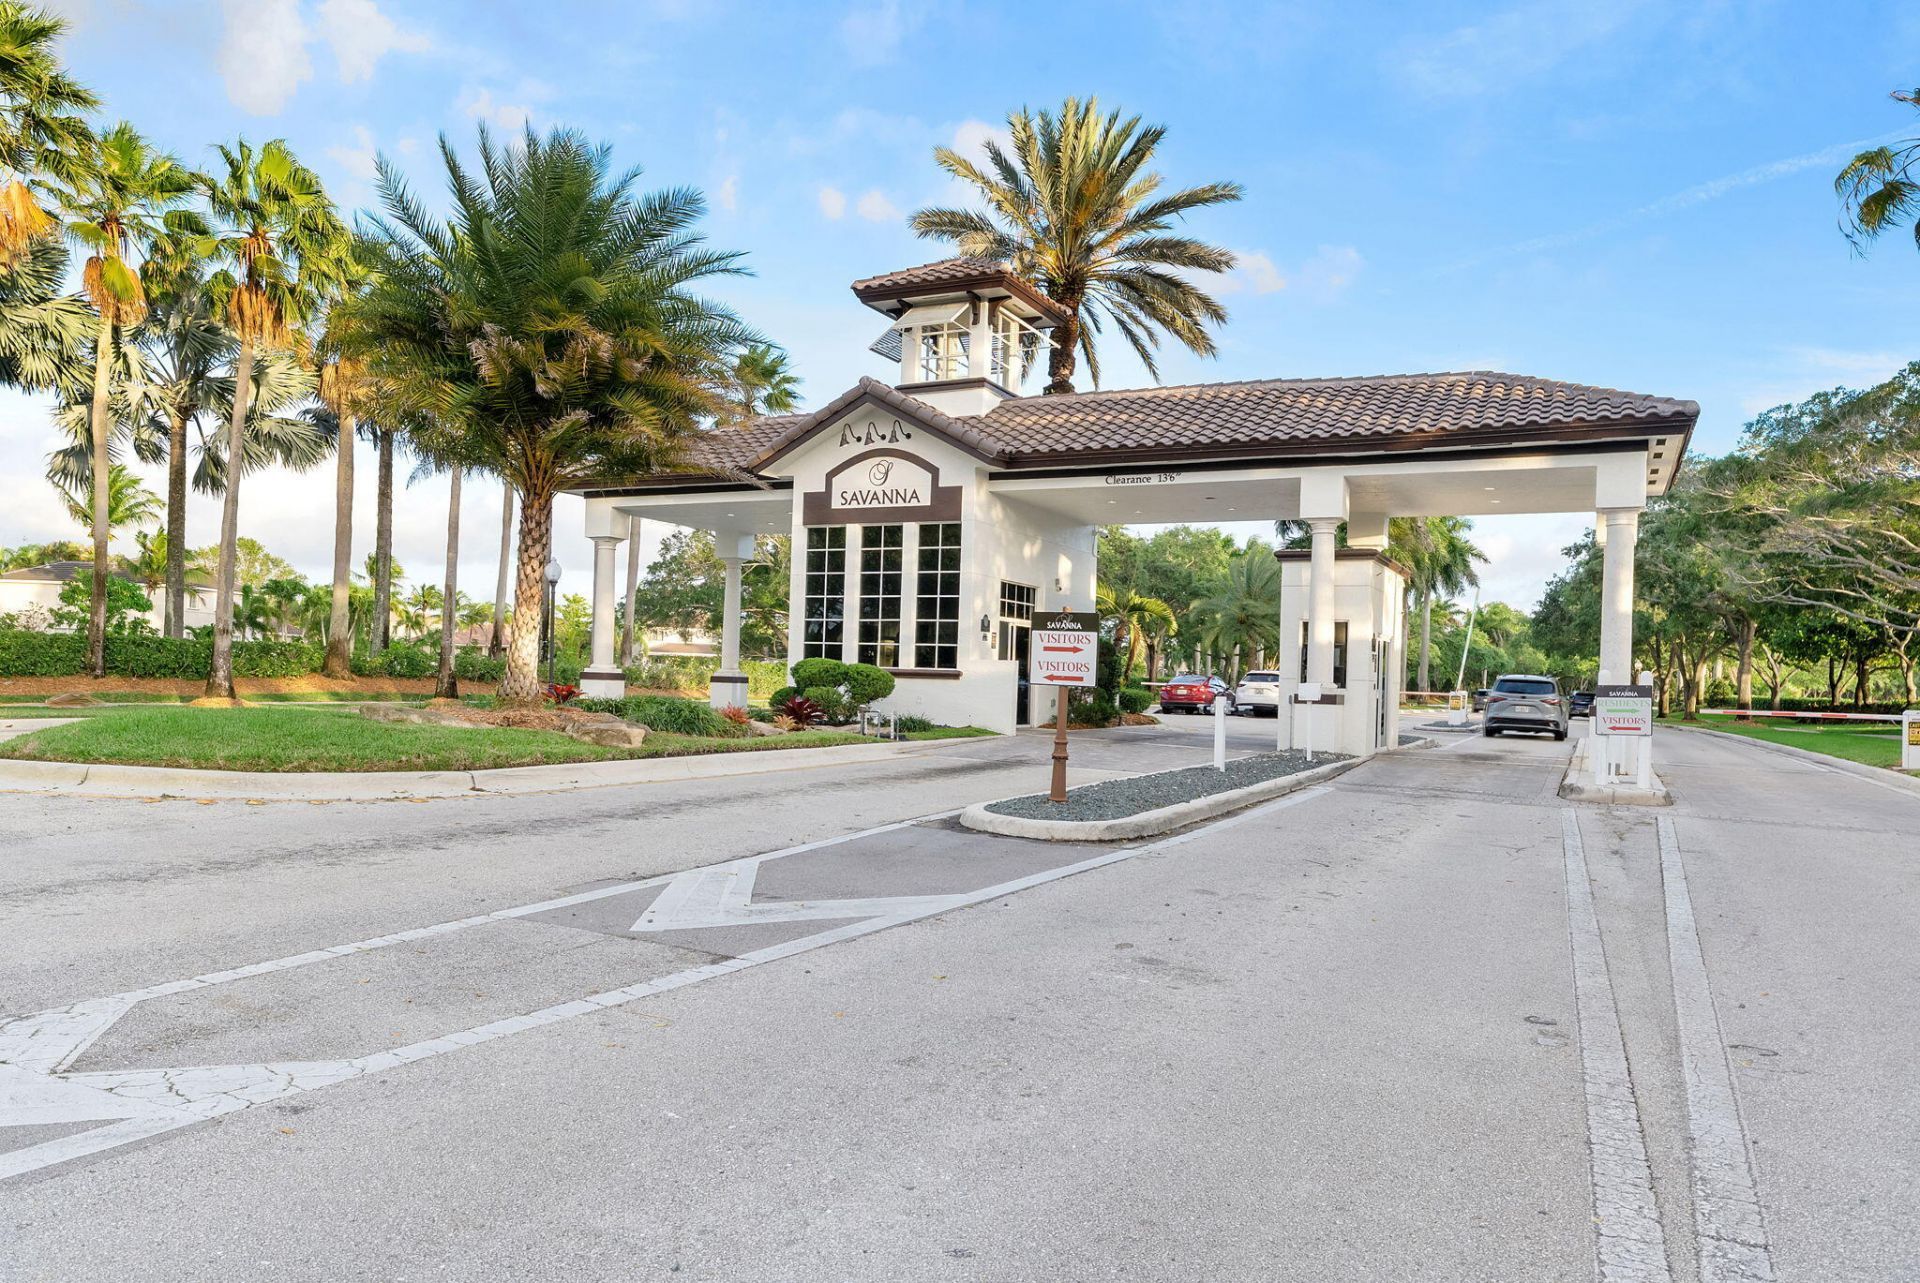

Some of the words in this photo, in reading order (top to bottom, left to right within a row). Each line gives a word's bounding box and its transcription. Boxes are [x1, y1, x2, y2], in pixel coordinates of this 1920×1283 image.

[1105, 475, 1151, 485] Clearance
[841, 489, 920, 505] SAVANNA
[1047, 621, 1082, 630] SAVANNA
[1039, 633, 1091, 645] VISITORS
[1038, 661, 1090, 673] VISITORS
[1603, 716, 1646, 724] VISITORS
